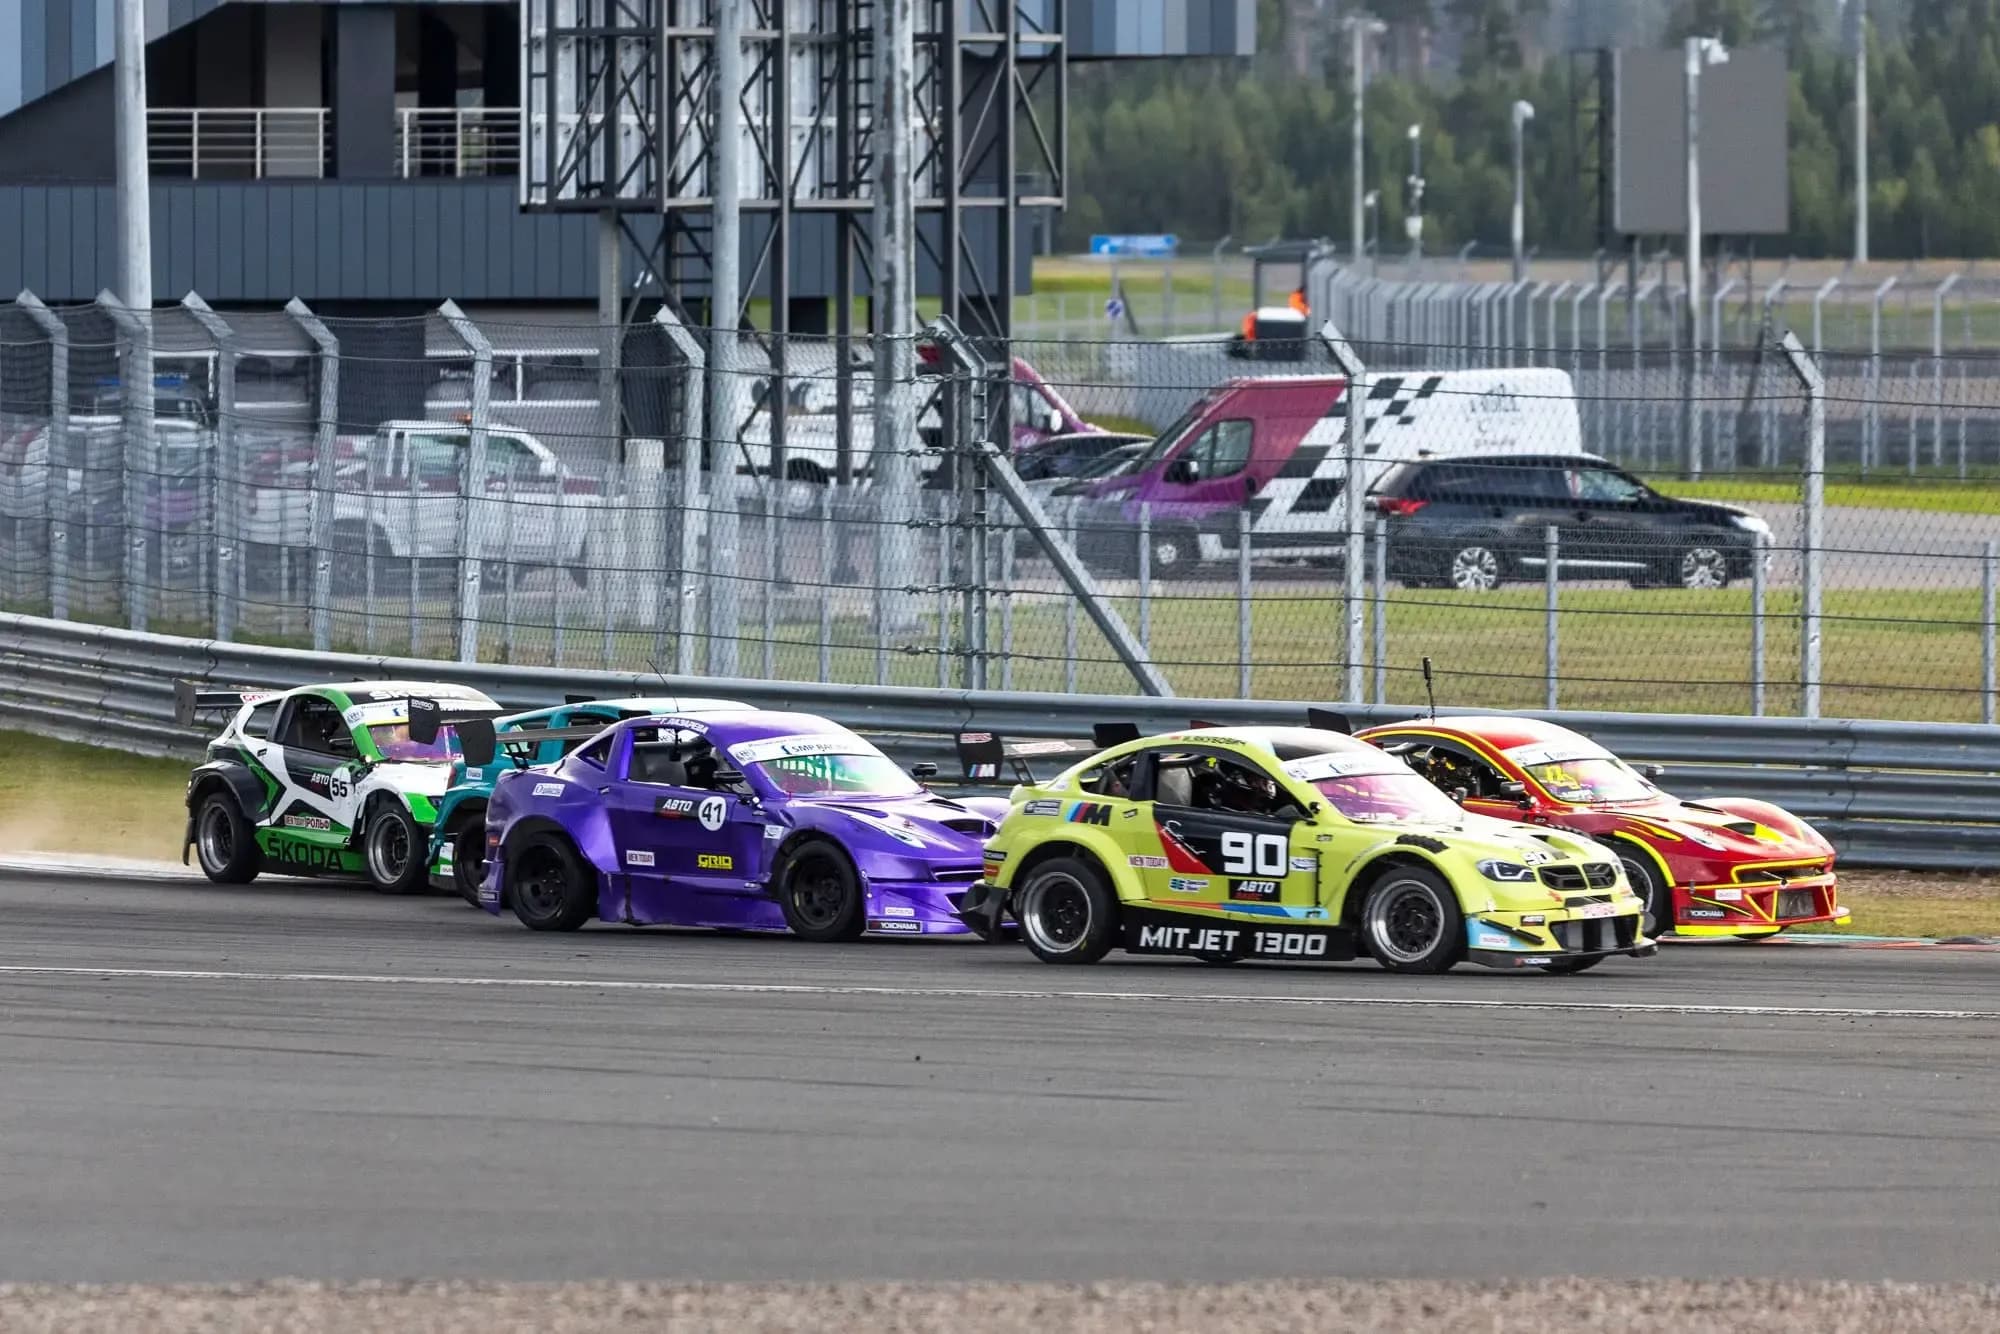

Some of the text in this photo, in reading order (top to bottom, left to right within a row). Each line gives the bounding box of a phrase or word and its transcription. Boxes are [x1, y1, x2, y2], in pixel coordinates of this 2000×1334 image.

[331, 777, 348, 797] 55
[701, 802, 723, 823] 41
[698, 854, 733, 868] GRID
[1221, 832, 1288, 876] 90
[880, 922, 918, 930] YOKOHAMA
[1254, 931, 1328, 956] 1300
